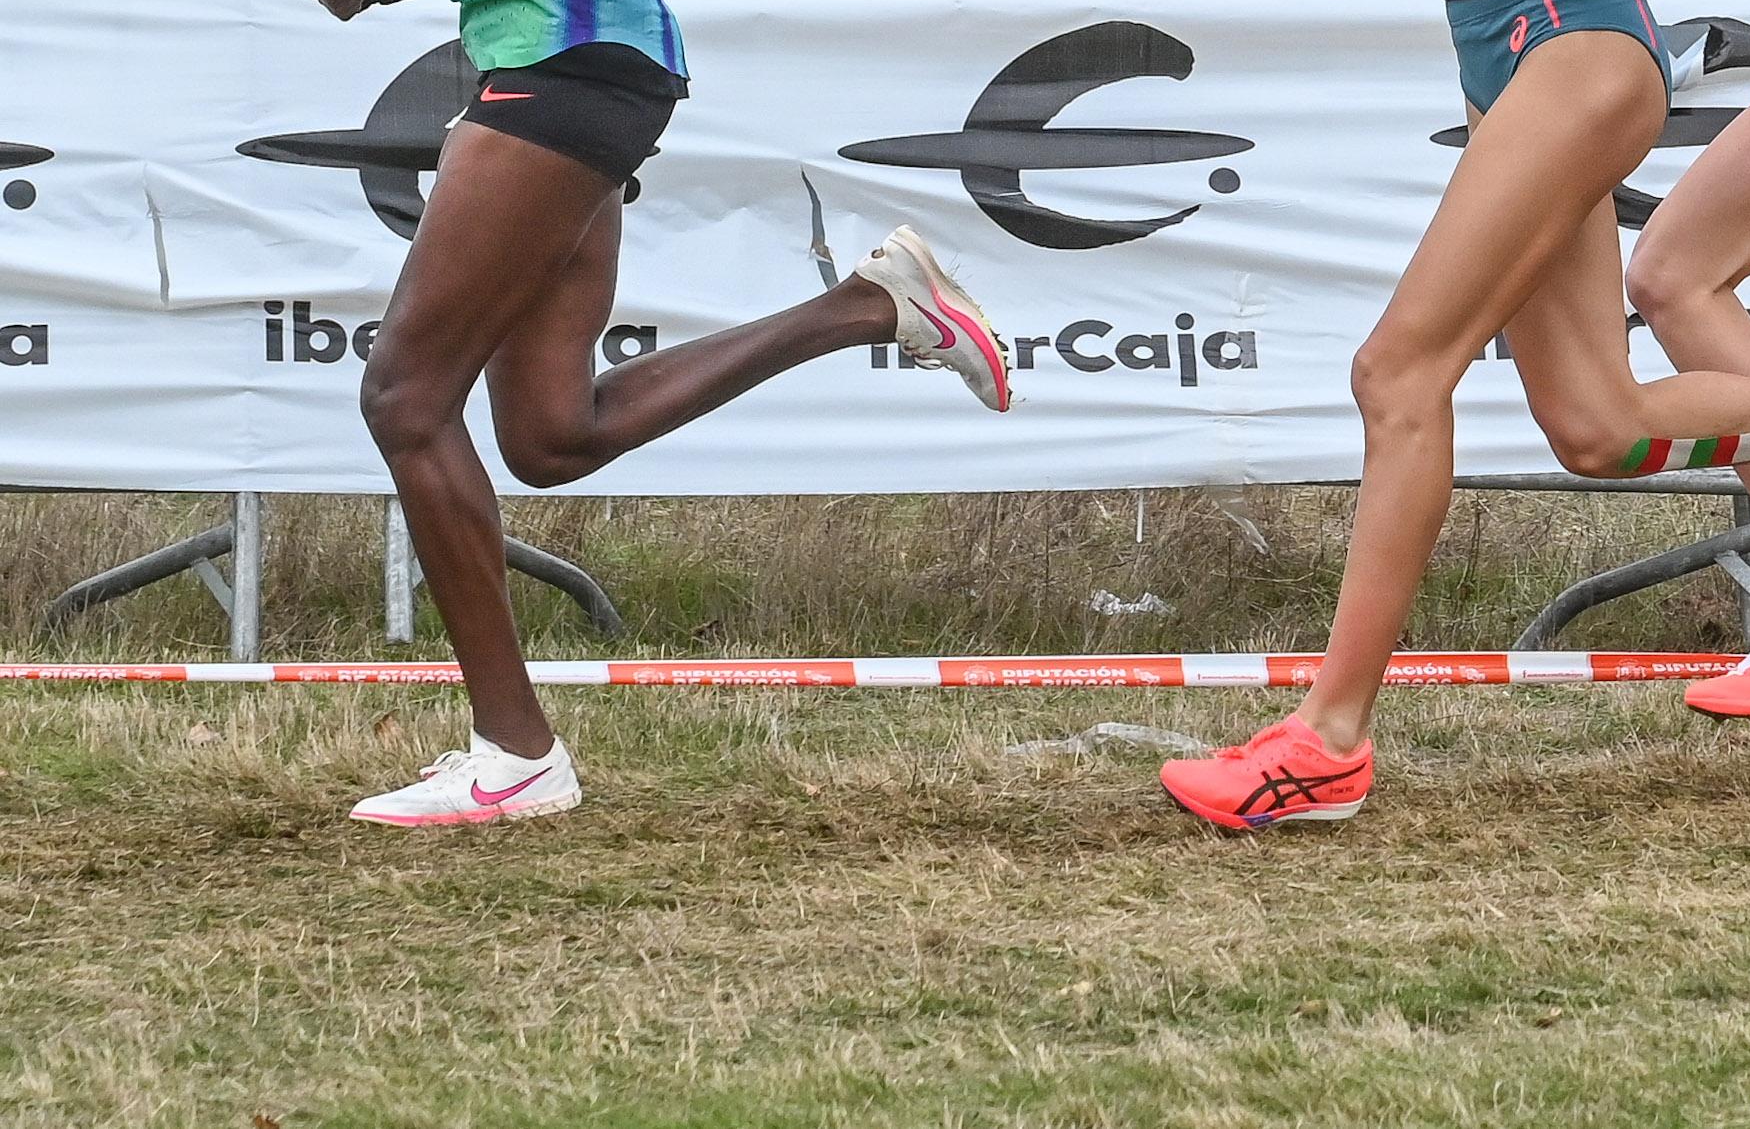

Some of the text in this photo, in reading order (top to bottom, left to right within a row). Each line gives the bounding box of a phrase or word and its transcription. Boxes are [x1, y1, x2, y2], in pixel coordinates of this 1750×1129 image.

[870, 312, 1258, 387] rCaja
[671, 668, 797, 678] DIPUTACIÓN
[1002, 666, 1127, 677] DIPUTACIÓN
